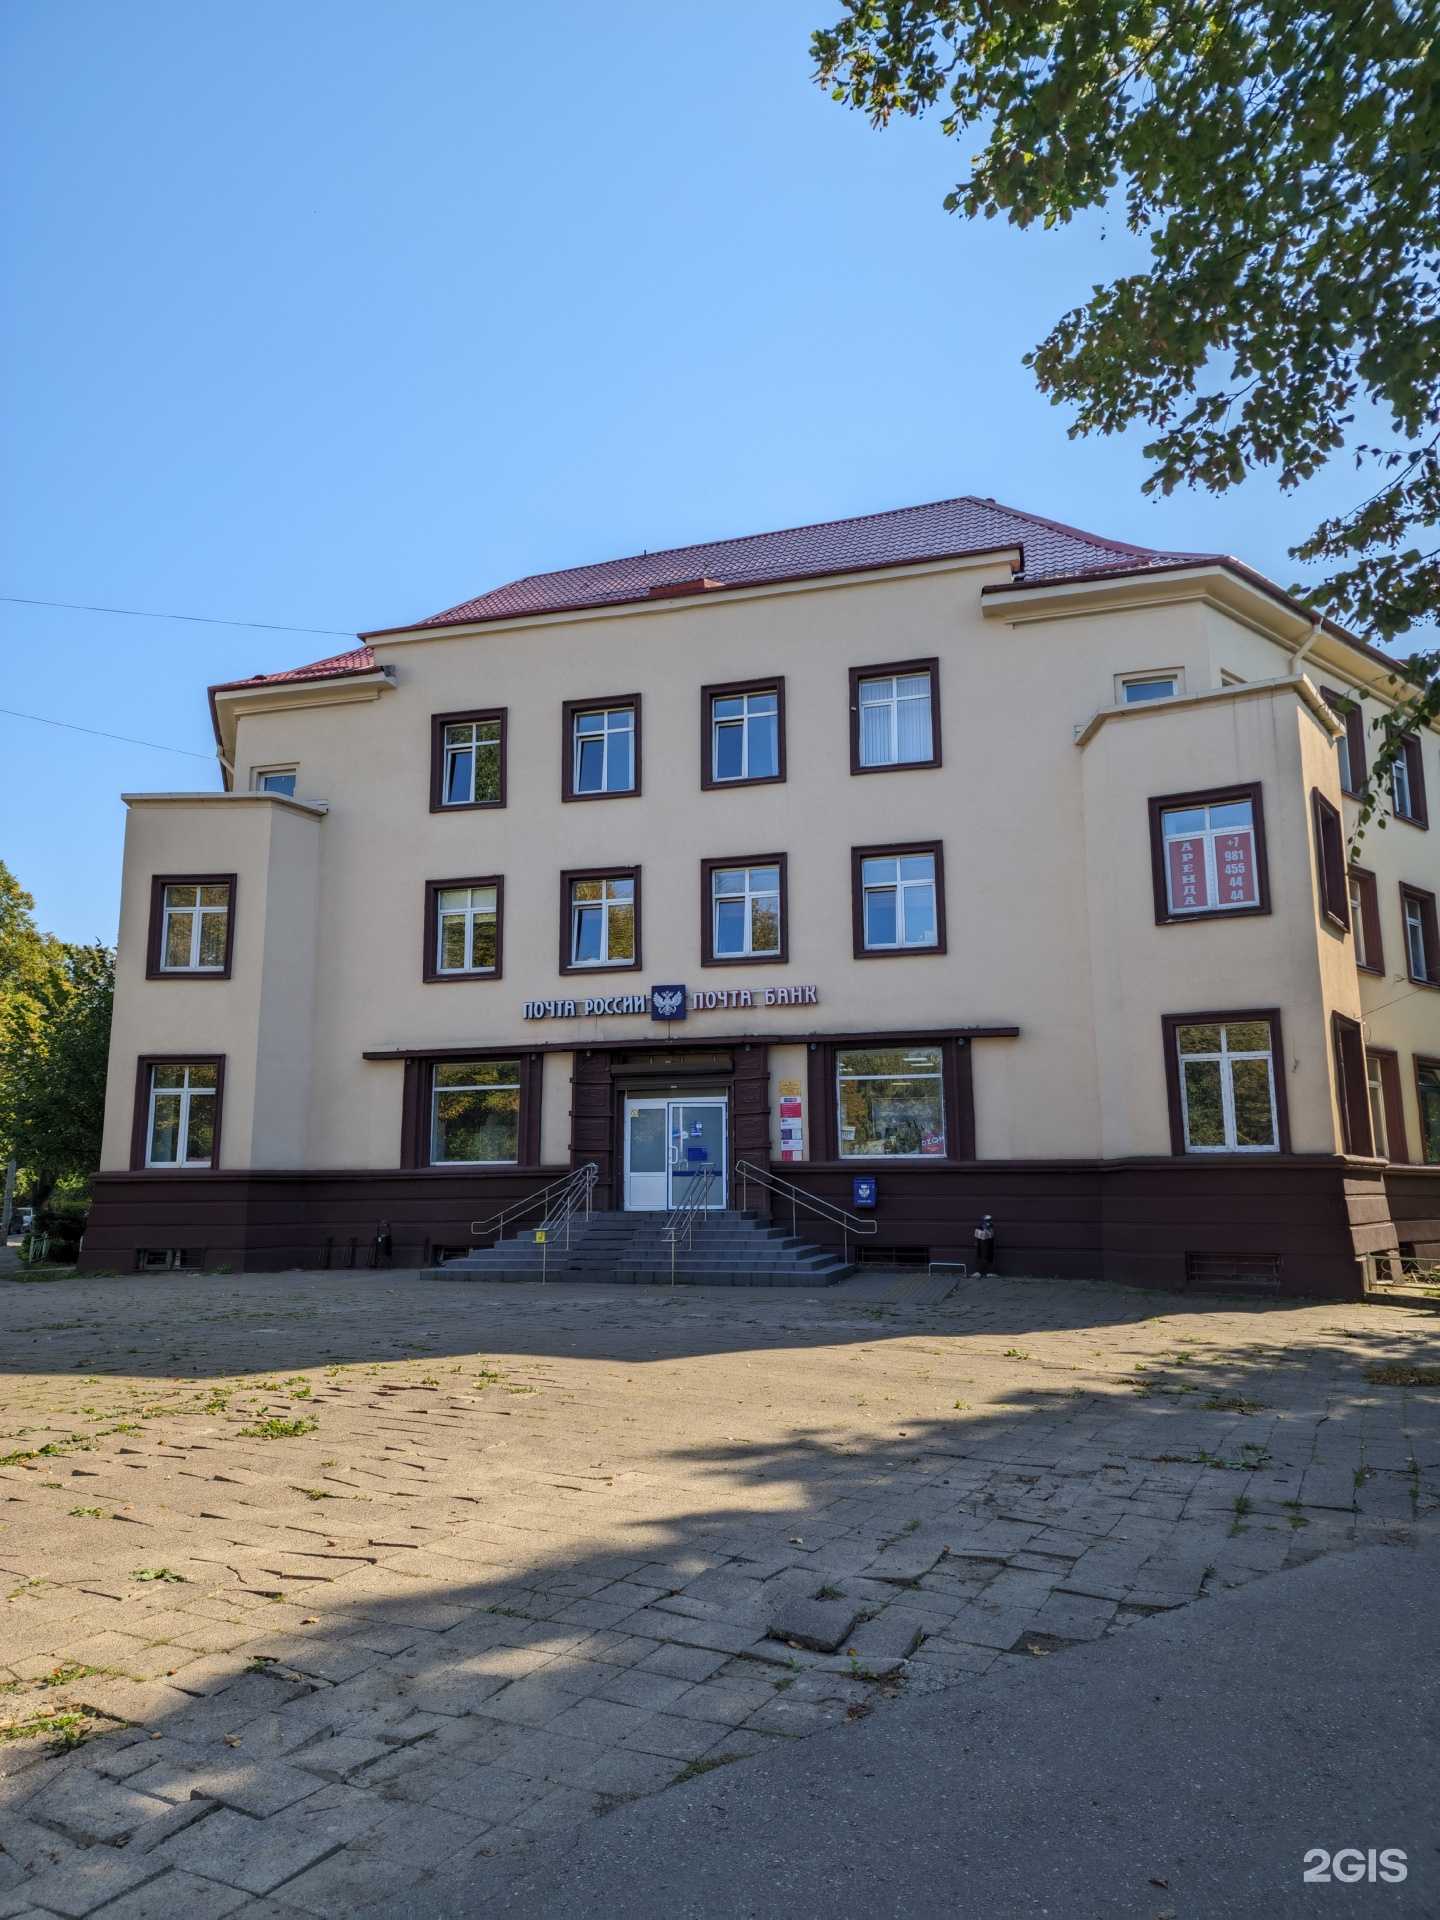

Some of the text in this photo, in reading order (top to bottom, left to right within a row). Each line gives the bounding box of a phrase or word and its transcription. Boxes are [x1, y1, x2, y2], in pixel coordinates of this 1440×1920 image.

[1227, 837, 1239, 848] +7
[1224, 850, 1244, 861] 981
[1181, 842, 1197, 905] АРЕНДА
[1225, 863, 1245, 875] 455
[1230, 876, 1244, 887] 44
[693, 984, 818, 1010] ПОЧТА БАНК
[522, 994, 647, 1020] ПОЧТА РОССИИ
